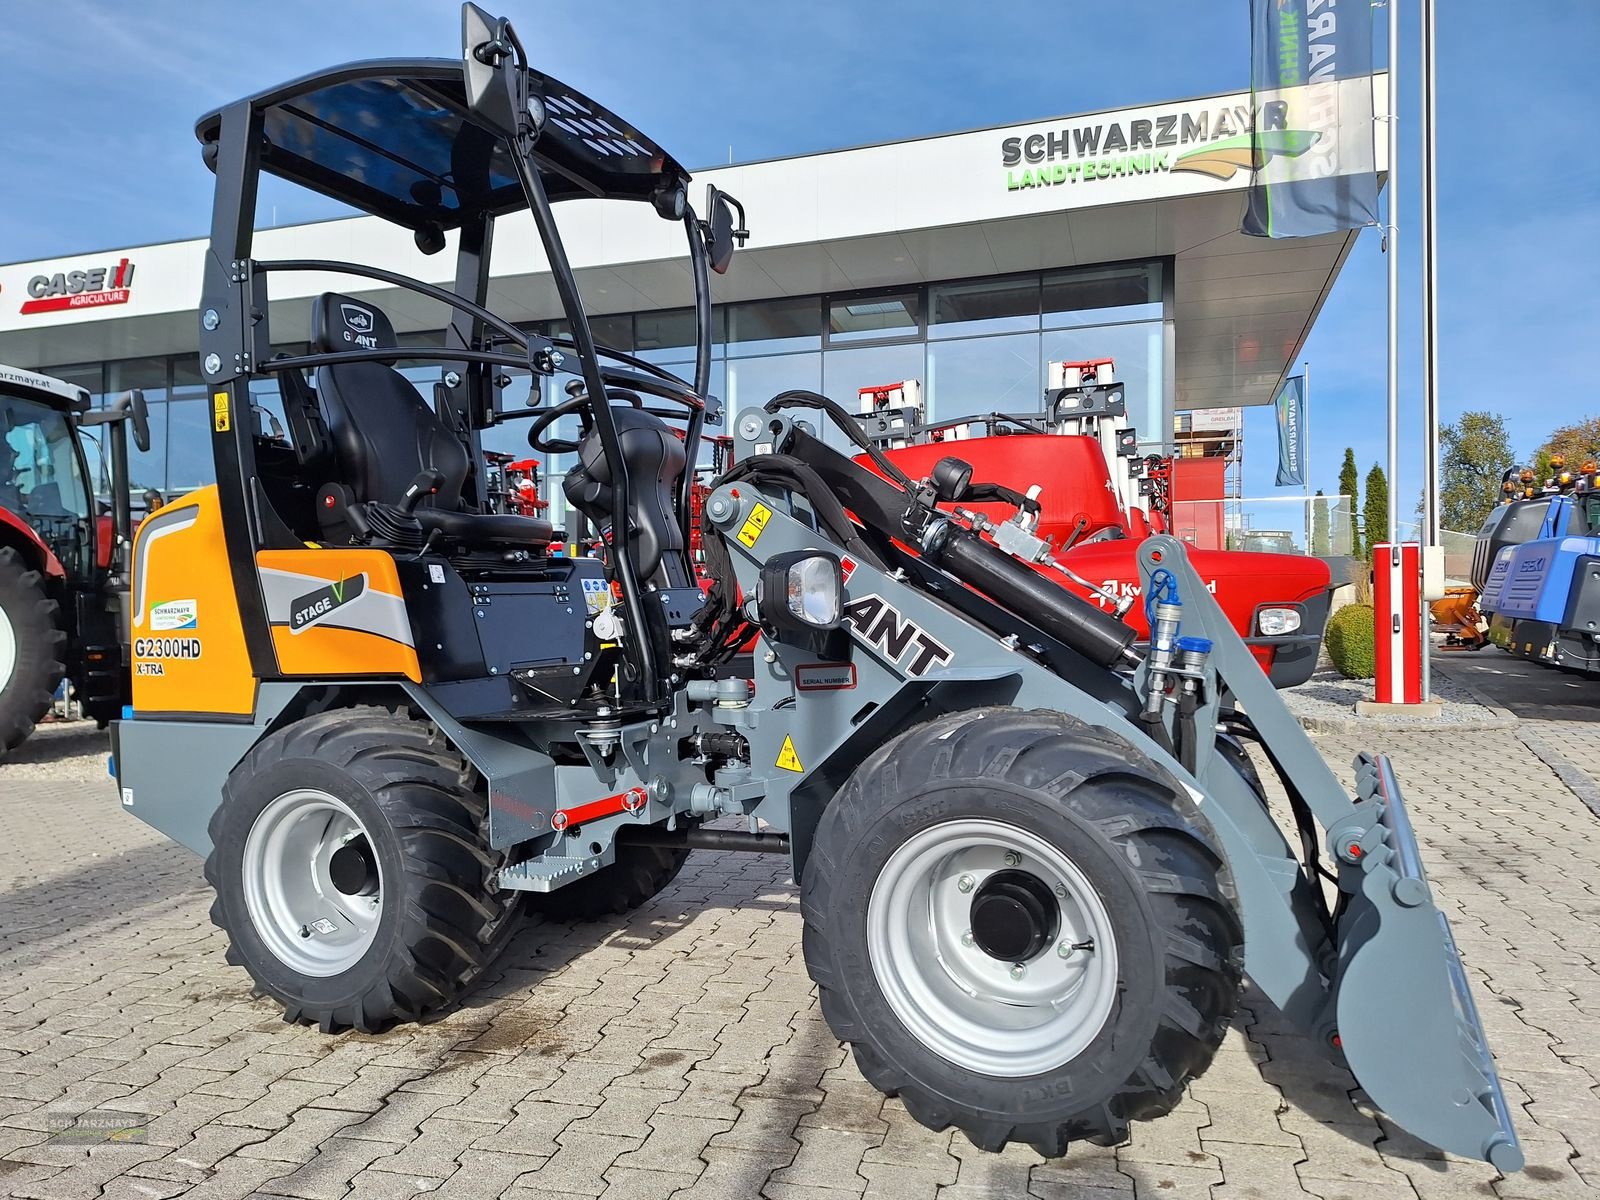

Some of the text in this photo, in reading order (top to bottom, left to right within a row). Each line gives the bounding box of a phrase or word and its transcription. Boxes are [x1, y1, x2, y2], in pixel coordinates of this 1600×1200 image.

[1002, 100, 1288, 166] SCHWARZMAYR
[1007, 150, 1170, 191] LANDTECHNIK
[27, 268, 107, 298] CASE
[70, 291, 124, 306] AGRICULTURE
[154, 606, 190, 615] SCHWARZMAYR
[295, 597, 332, 624] STAGE
[135, 638, 201, 658] G2300HD
[136, 663, 164, 675] X-TRA
[824, 677, 850, 685] NUMBER
